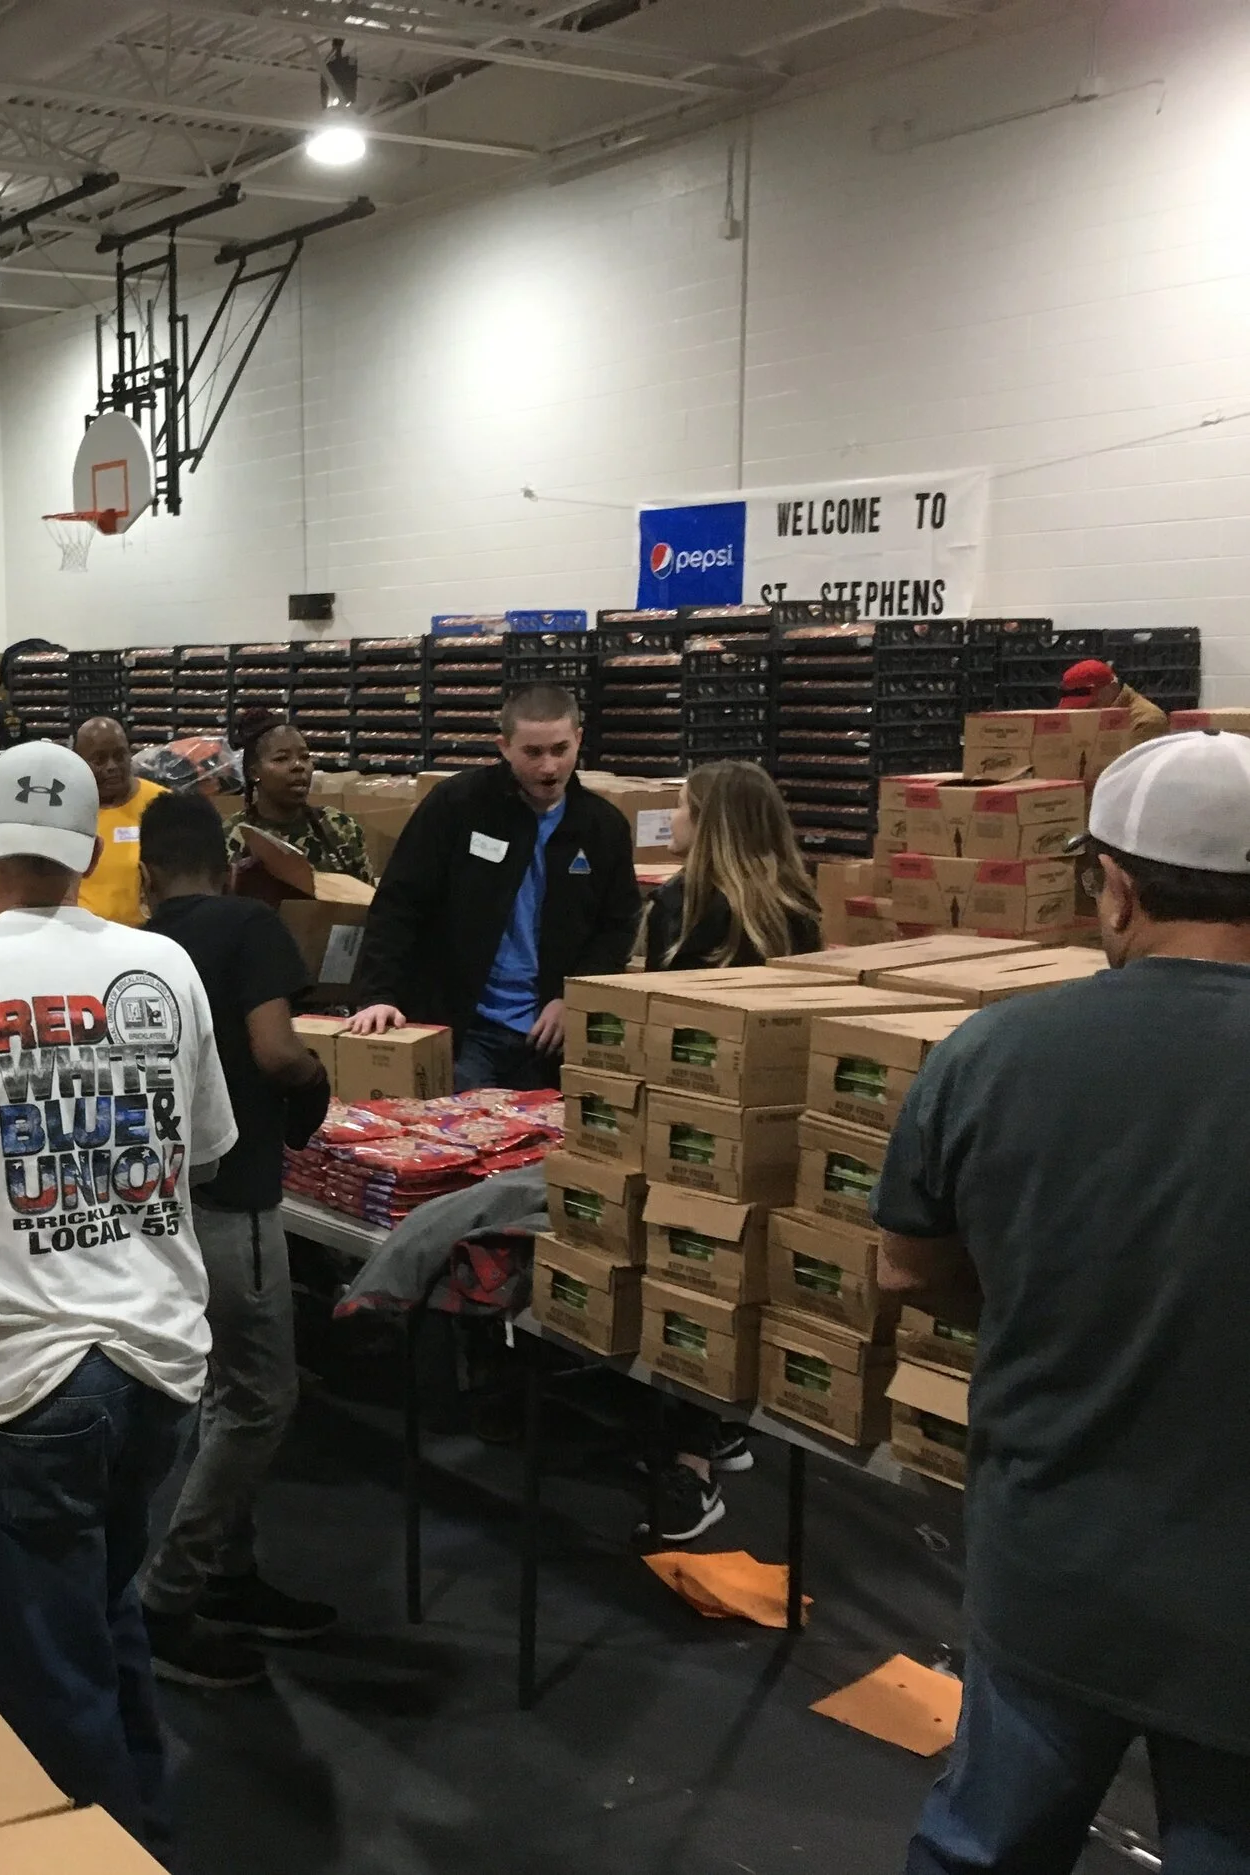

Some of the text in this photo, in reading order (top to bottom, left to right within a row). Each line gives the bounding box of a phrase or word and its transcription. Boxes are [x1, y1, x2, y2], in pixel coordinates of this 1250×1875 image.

[777, 492, 947, 536] WELCOME TO
[675, 543, 735, 575] pepsi
[820, 579, 947, 617] STEPHENS
[0, 1090, 182, 1158] BLUE &
[12, 1200, 185, 1231] BRICKLAYER
[28, 1213, 180, 1255] LOCAL 55
